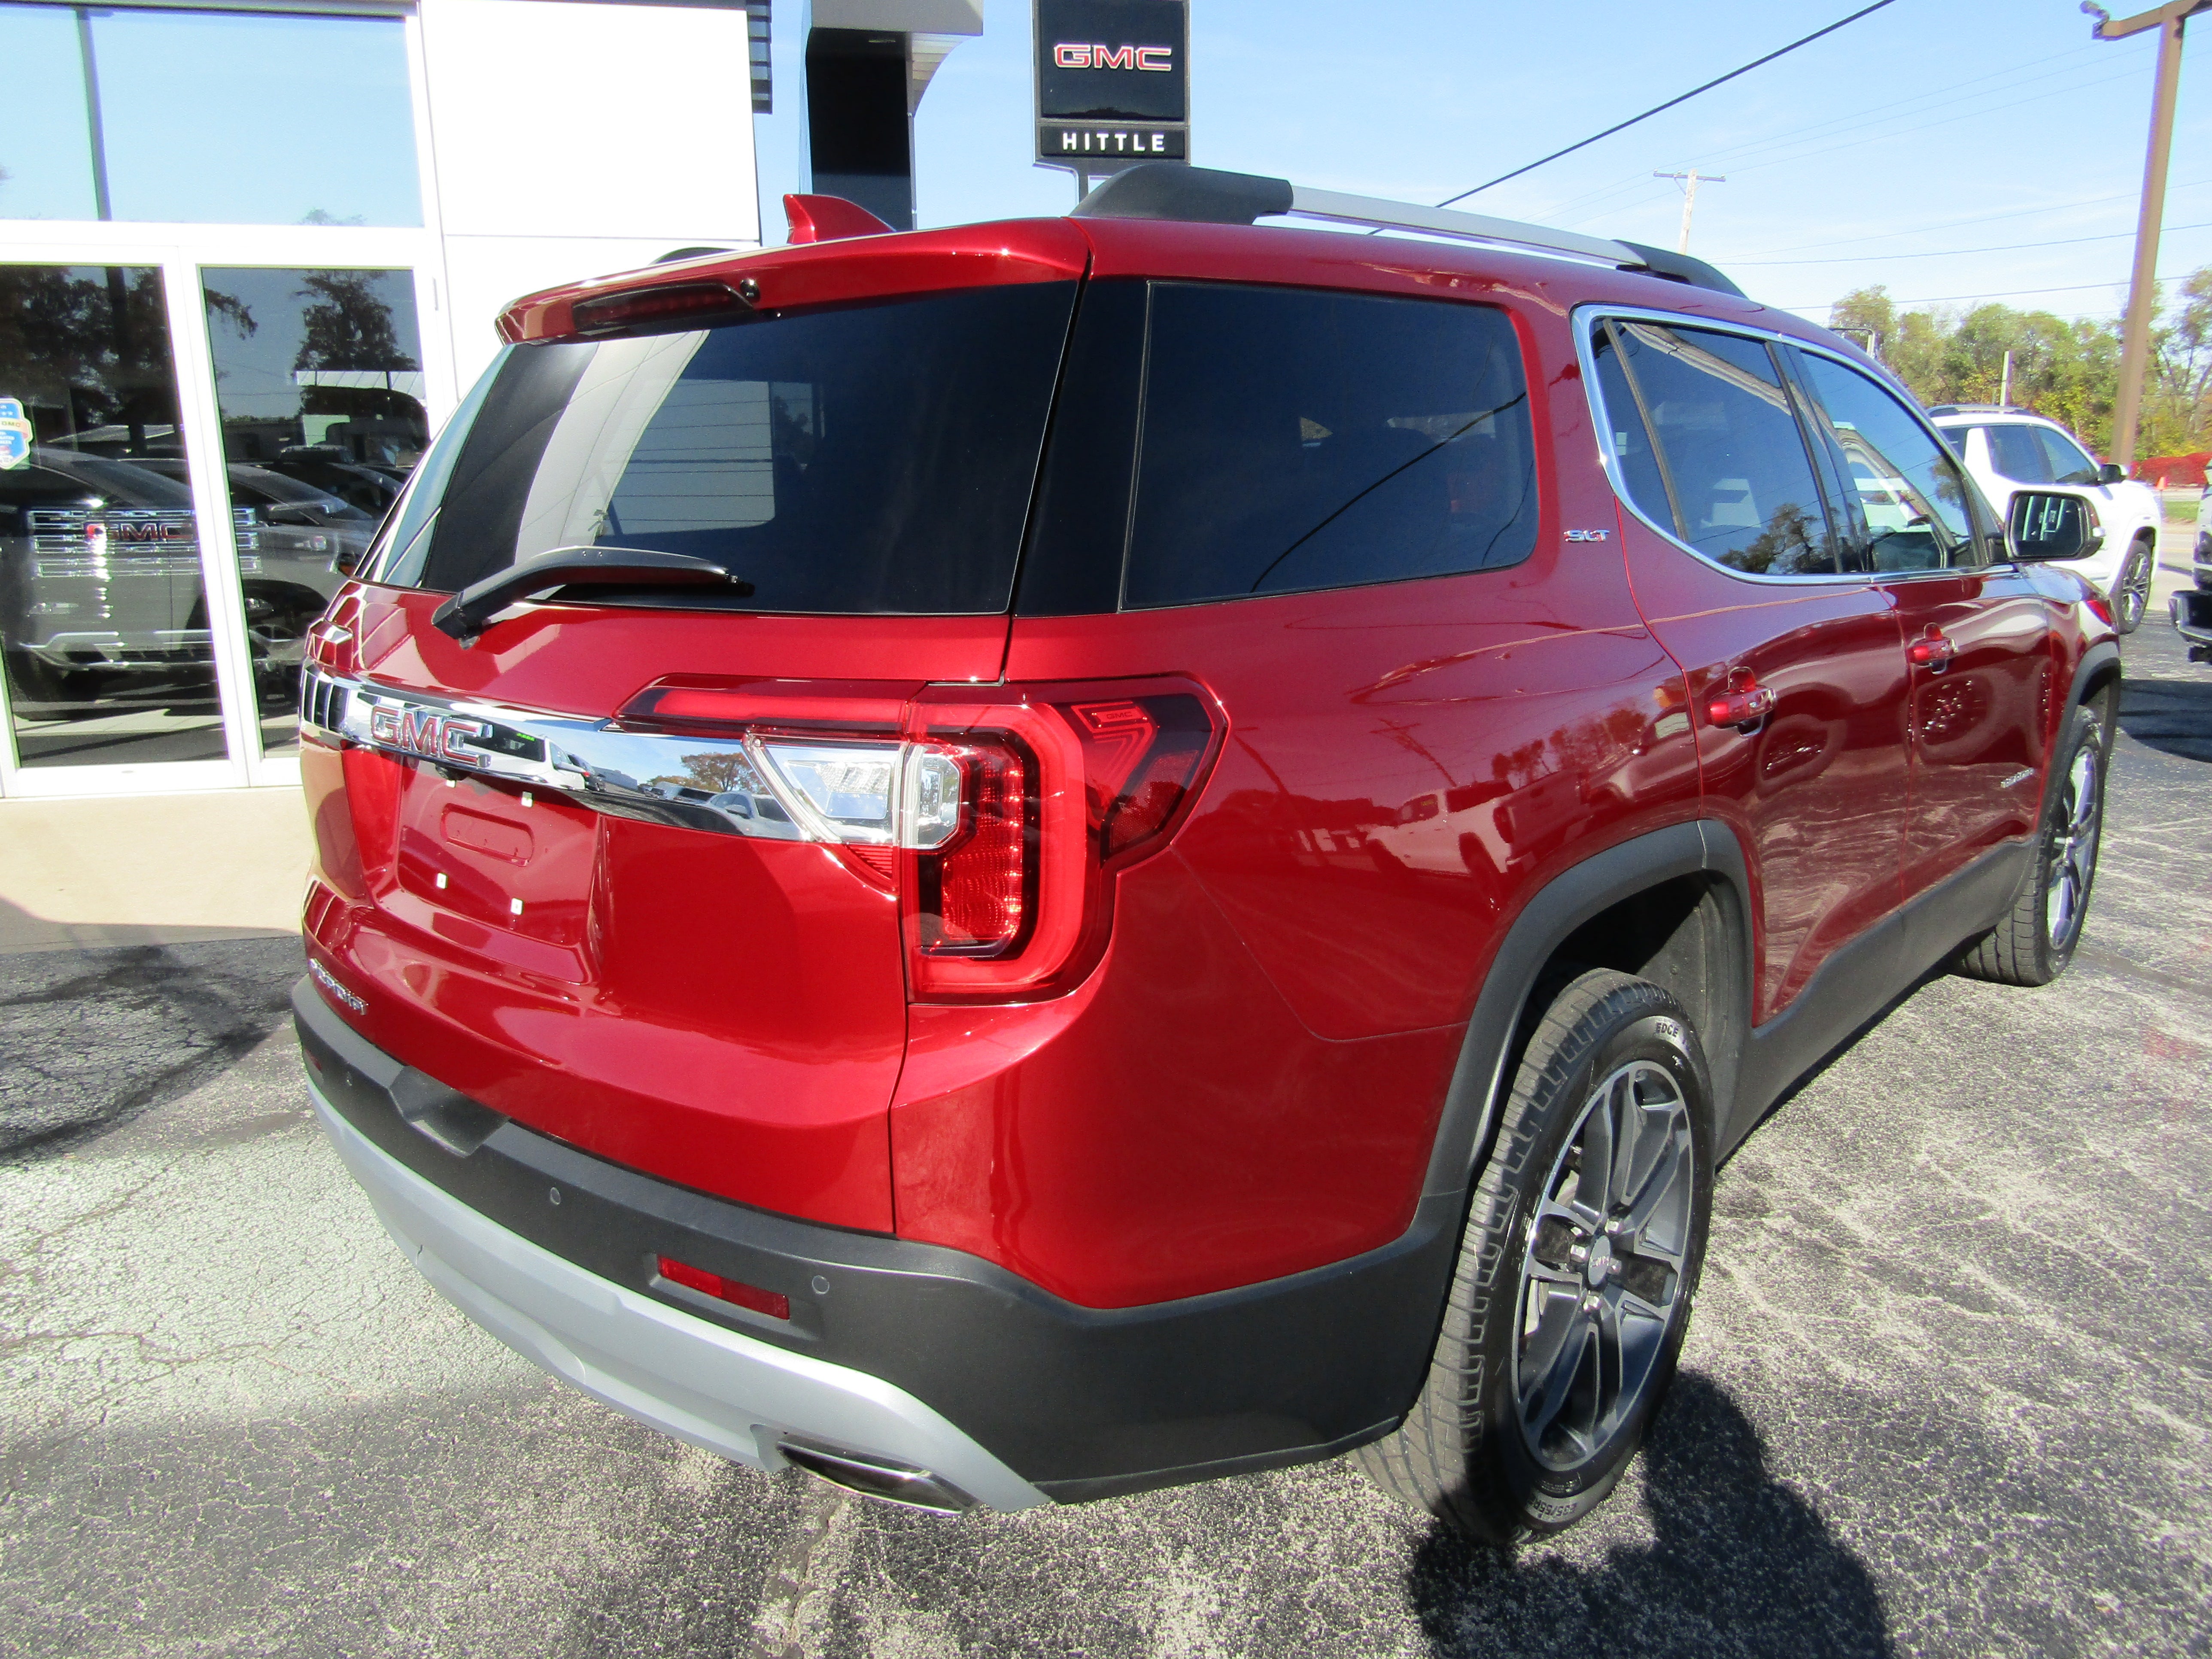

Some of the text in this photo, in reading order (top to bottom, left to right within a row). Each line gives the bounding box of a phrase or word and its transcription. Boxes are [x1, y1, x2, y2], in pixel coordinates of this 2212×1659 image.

[1054, 44, 1171, 71] GMC
[1062, 133, 1165, 152] HITTLE
[86, 523, 192, 541] GMC
[1563, 529, 1610, 542] SLT
[371, 702, 493, 768] GMC
